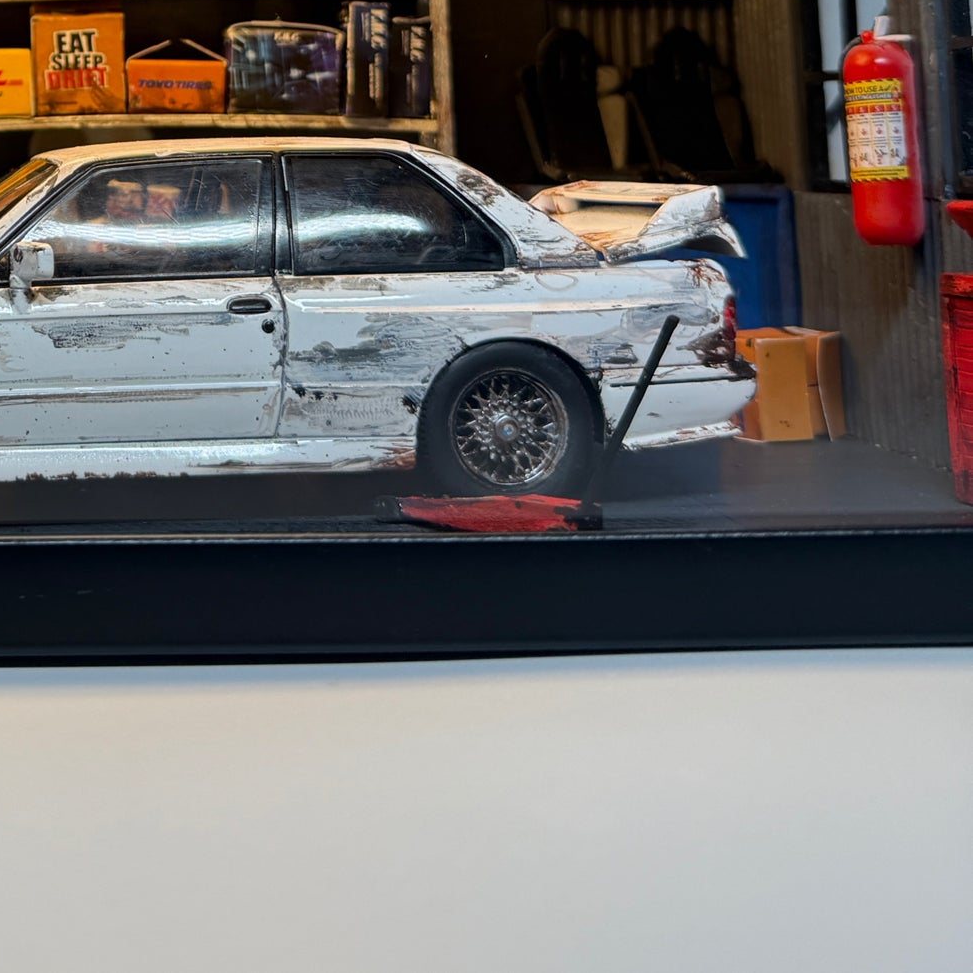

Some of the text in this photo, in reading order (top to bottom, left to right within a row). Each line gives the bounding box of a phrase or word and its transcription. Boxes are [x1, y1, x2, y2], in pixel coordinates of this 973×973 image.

[55, 31, 96, 54] EAT
[50, 54, 104, 70] SLEEP
[138, 79, 213, 90] TOYO TIRES
